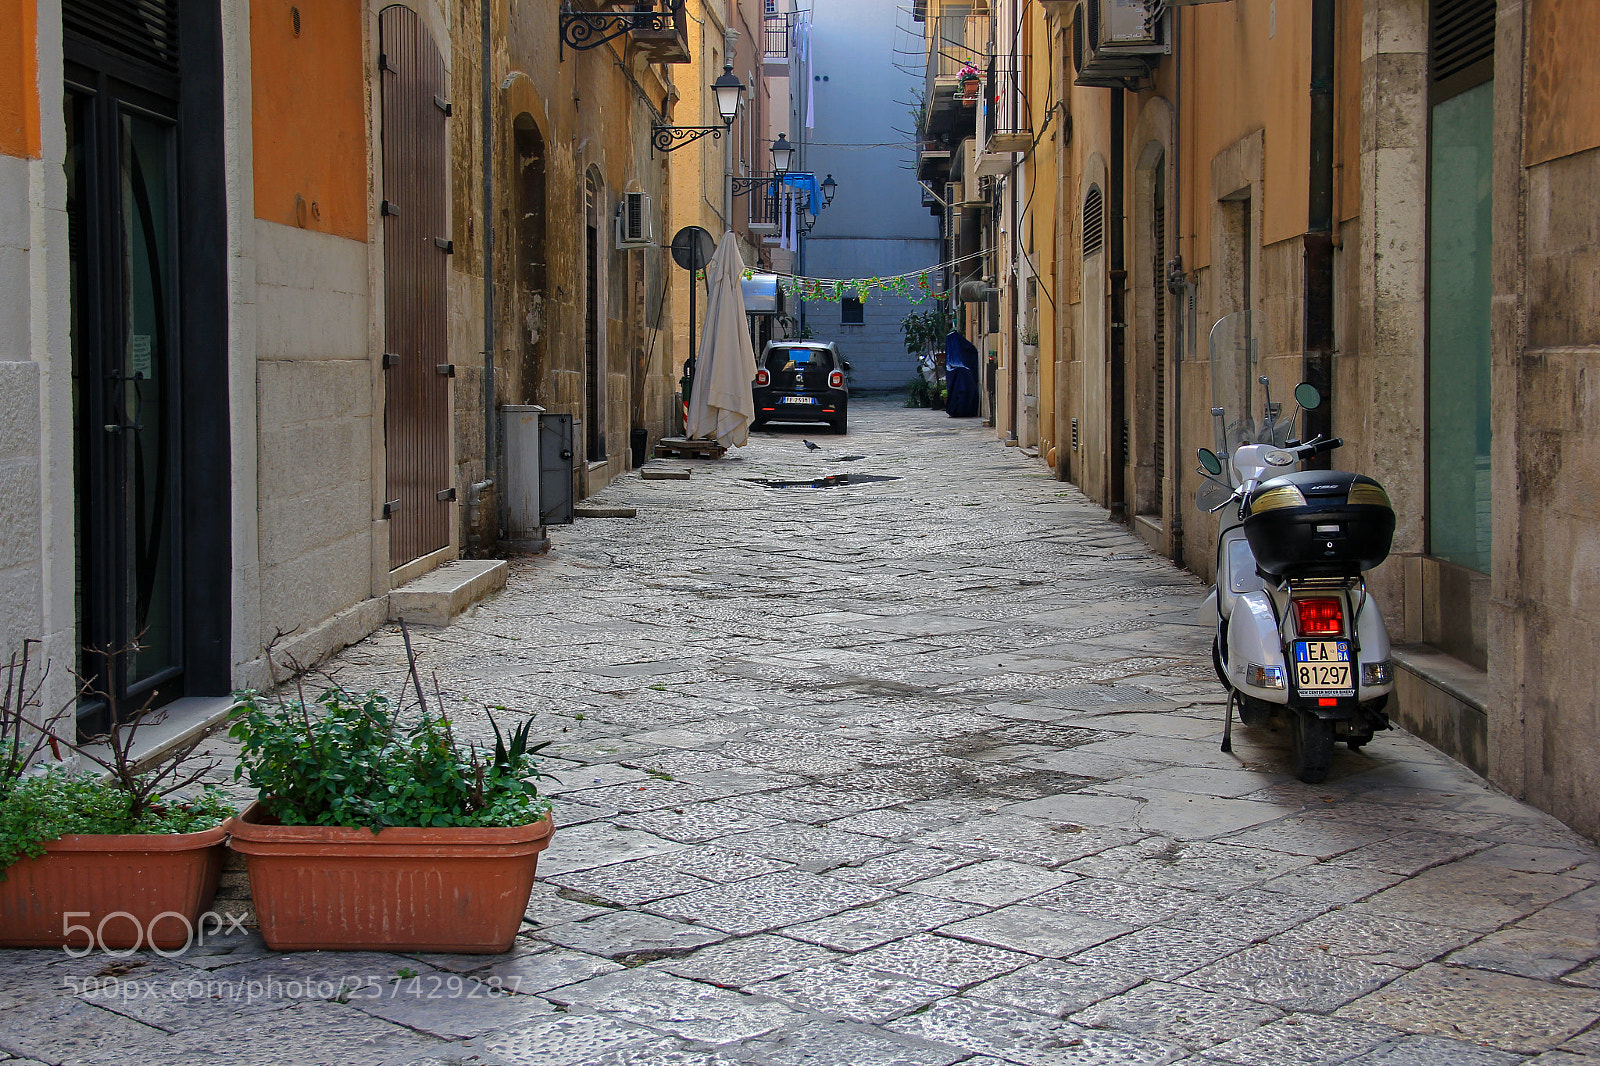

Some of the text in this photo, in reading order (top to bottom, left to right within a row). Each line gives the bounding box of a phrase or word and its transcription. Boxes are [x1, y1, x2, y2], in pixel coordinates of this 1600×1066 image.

[1307, 643, 1329, 661] EA
[1337, 652, 1349, 661] BA
[1299, 666, 1349, 685] 81297
